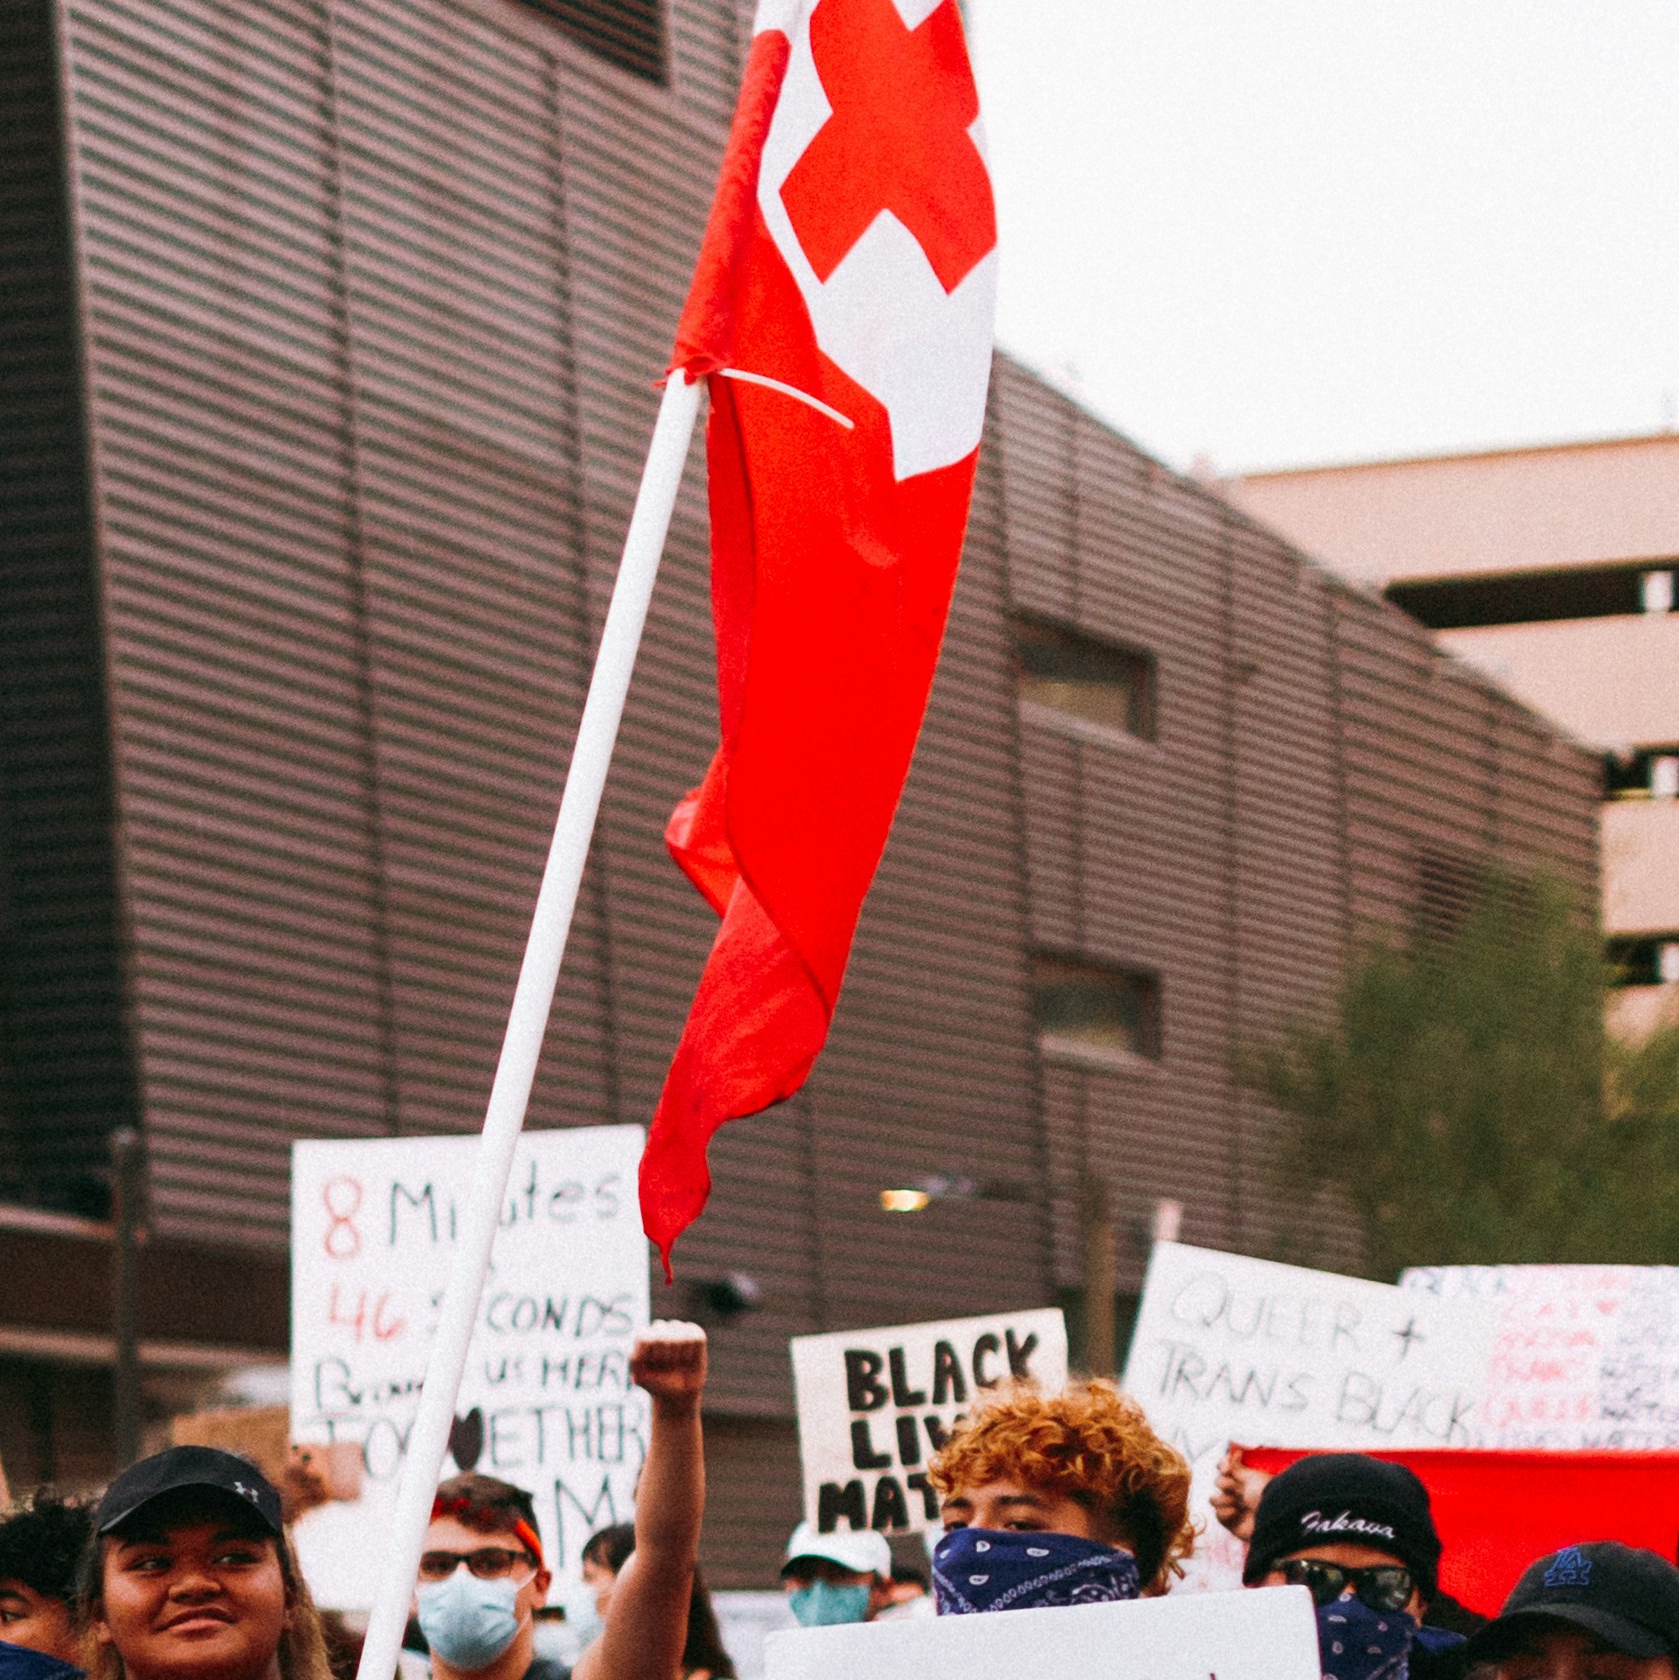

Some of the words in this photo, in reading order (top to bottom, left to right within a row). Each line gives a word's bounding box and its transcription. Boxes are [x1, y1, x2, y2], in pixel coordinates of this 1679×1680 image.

[323, 1175, 363, 1259] 8
[389, 1160, 621, 1246] Miutes
[328, 1285, 407, 1342] 46
[540, 1350, 633, 1390] HER
[845, 1329, 1039, 1412] BLACK
[1159, 1338, 1318, 1413] TRANS
[1337, 1370, 1479, 1444] BLACK
